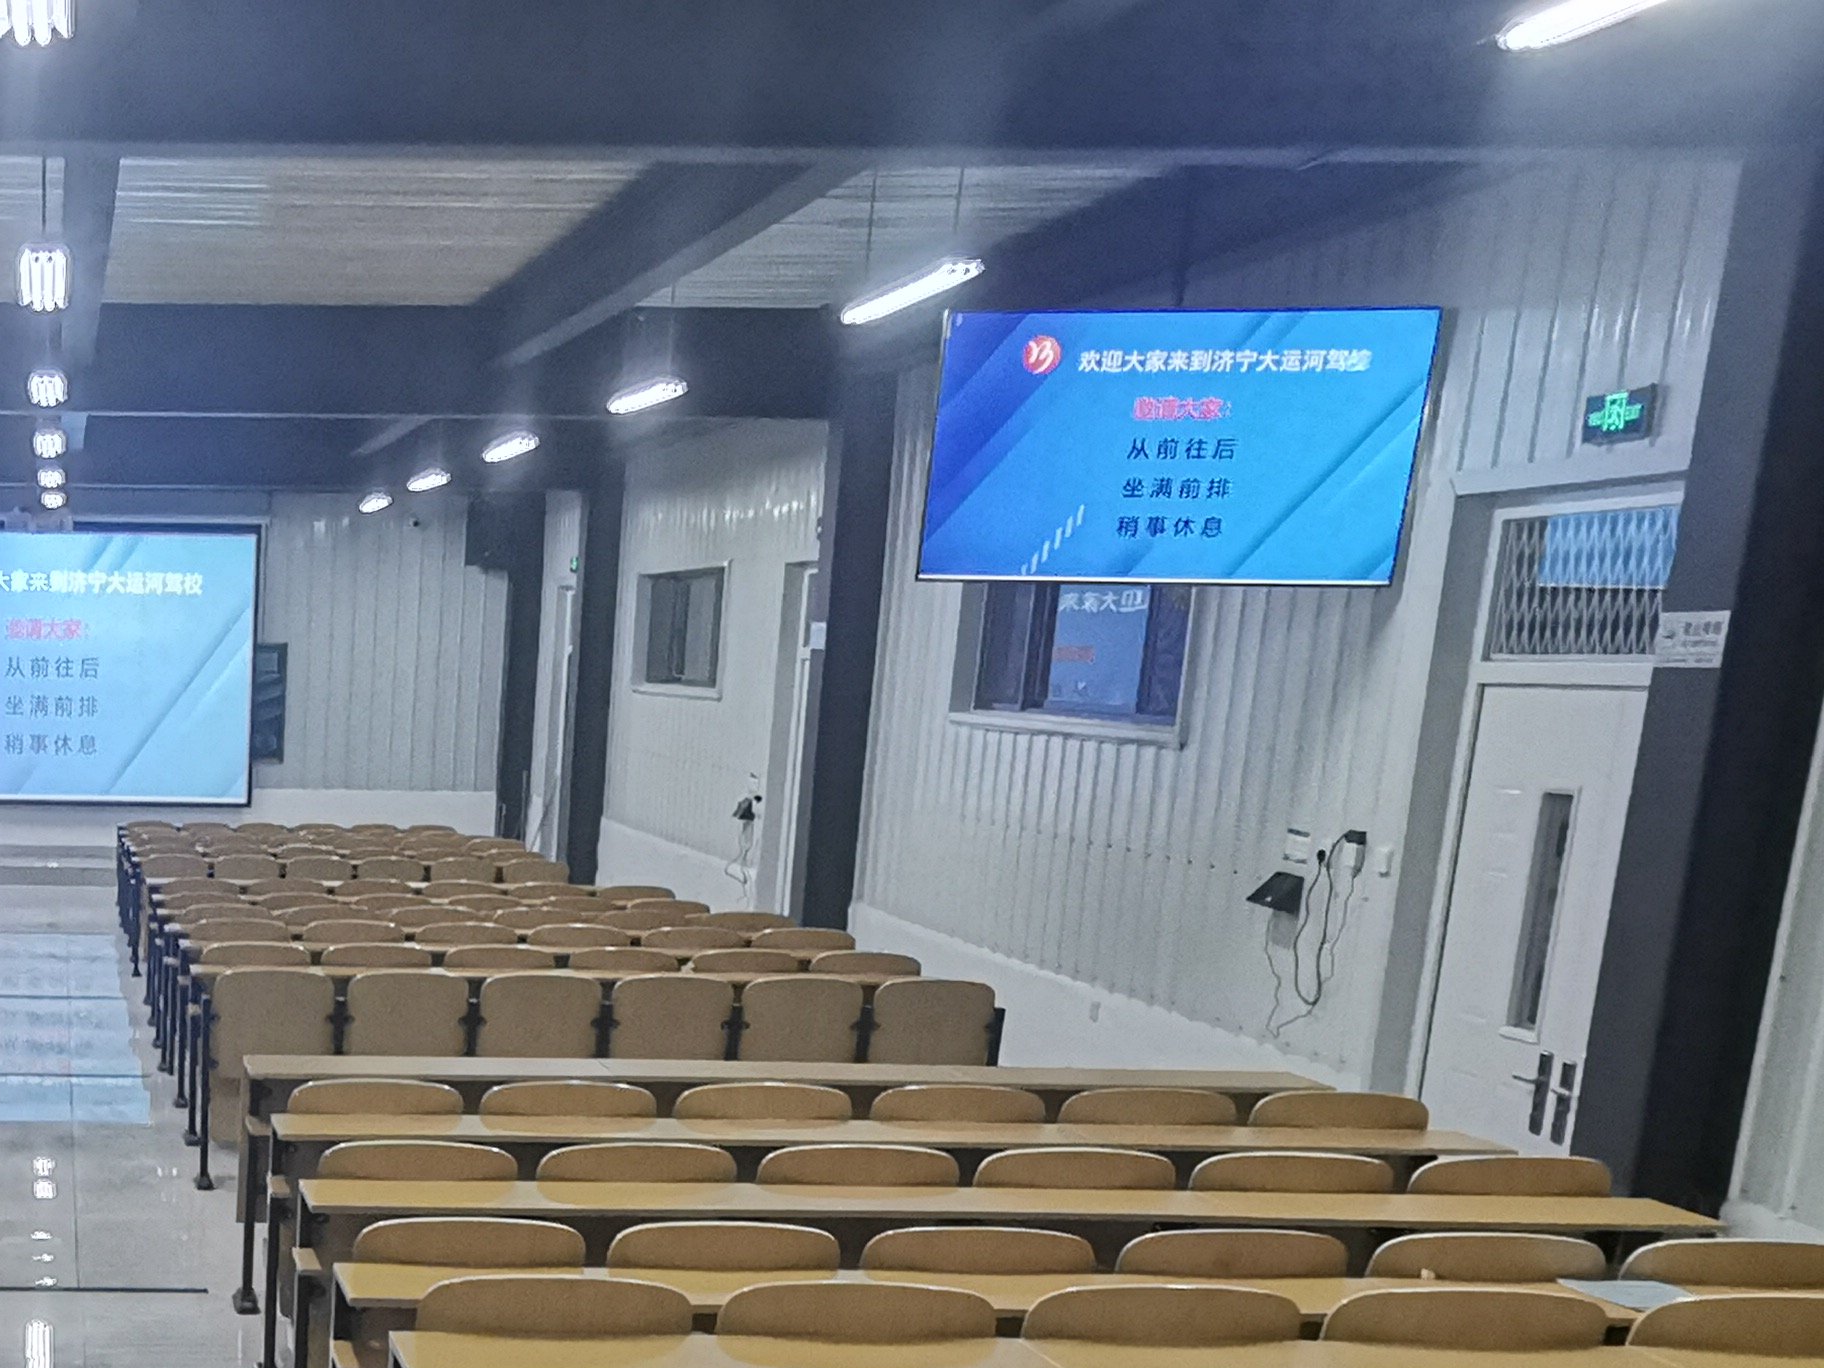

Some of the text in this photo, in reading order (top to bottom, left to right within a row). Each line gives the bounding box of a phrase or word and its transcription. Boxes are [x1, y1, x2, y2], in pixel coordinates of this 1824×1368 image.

[1078, 349, 1373, 372] 欢迎大家来到济宁大运河驾校
[1127, 438, 1239, 459] 从前往后
[1122, 477, 1231, 499] 坐满前排
[1116, 516, 1222, 538] 稍事休息
[5, 656, 99, 679] 从前往后
[5, 695, 98, 718] 坐满前排
[4, 732, 97, 755] 稍事休息
